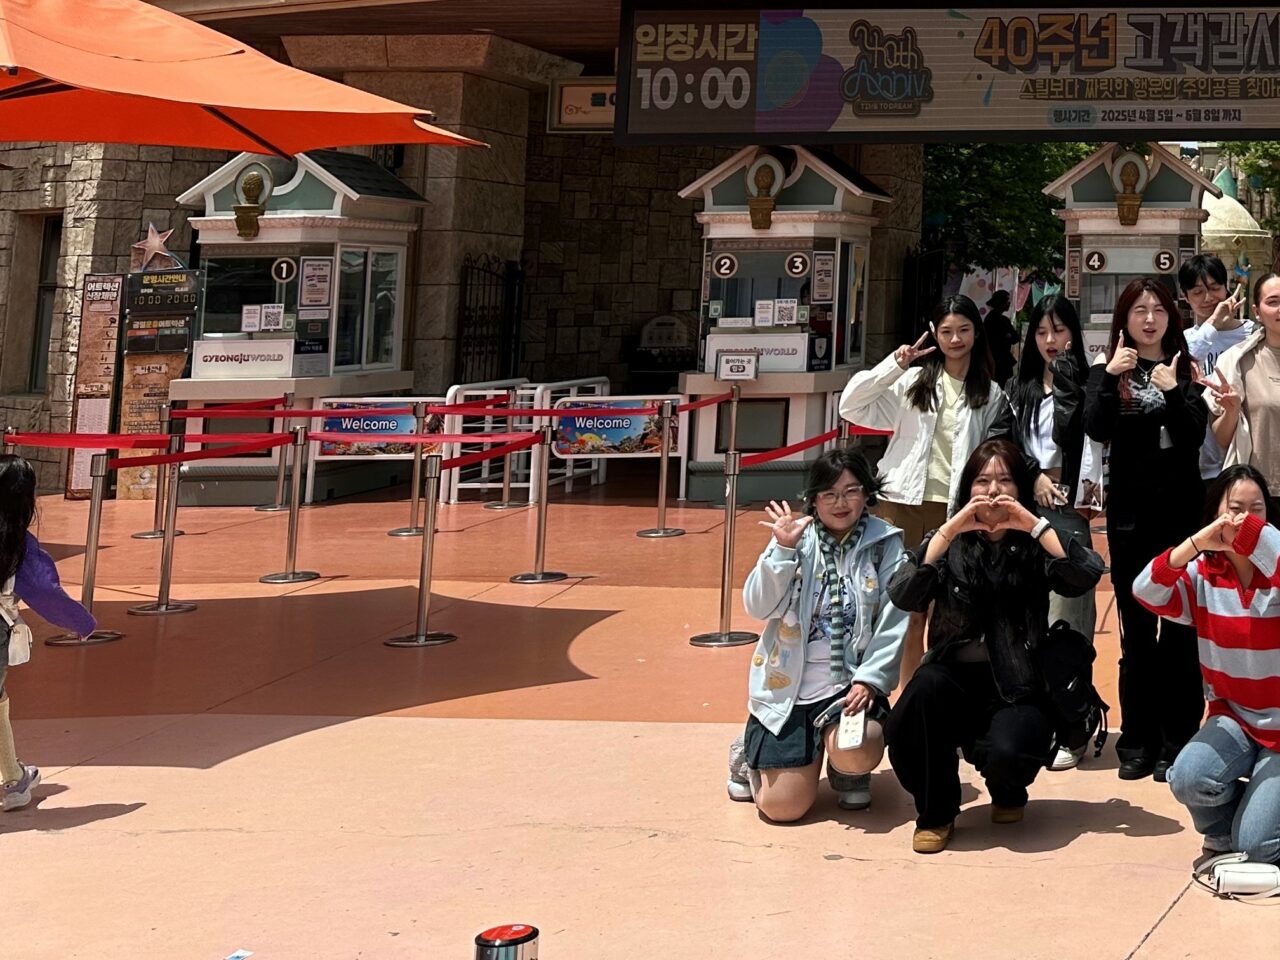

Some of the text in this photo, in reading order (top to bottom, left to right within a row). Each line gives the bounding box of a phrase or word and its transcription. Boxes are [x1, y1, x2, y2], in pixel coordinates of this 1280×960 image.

[635, 23, 758, 62] 입장시간
[974, 12, 1118, 69] 40주년
[636, 67, 751, 110] 10:00
[1085, 77, 1129, 99] 짜릿한
[1133, 77, 1177, 99] 행운의
[1183, 77, 1242, 99] 주인공을
[1053, 111, 1090, 123] 행사기간
[1101, 109, 1137, 123] 2025년
[1139, 109, 1155, 123] 4월
[1158, 109, 1174, 123] 5일
[1185, 109, 1202, 123] 6월
[1204, 109, 1220, 123] 8일
[1222, 109, 1241, 123] 까지
[341, 417, 398, 431] Welcome
[574, 416, 631, 430] Welcome
